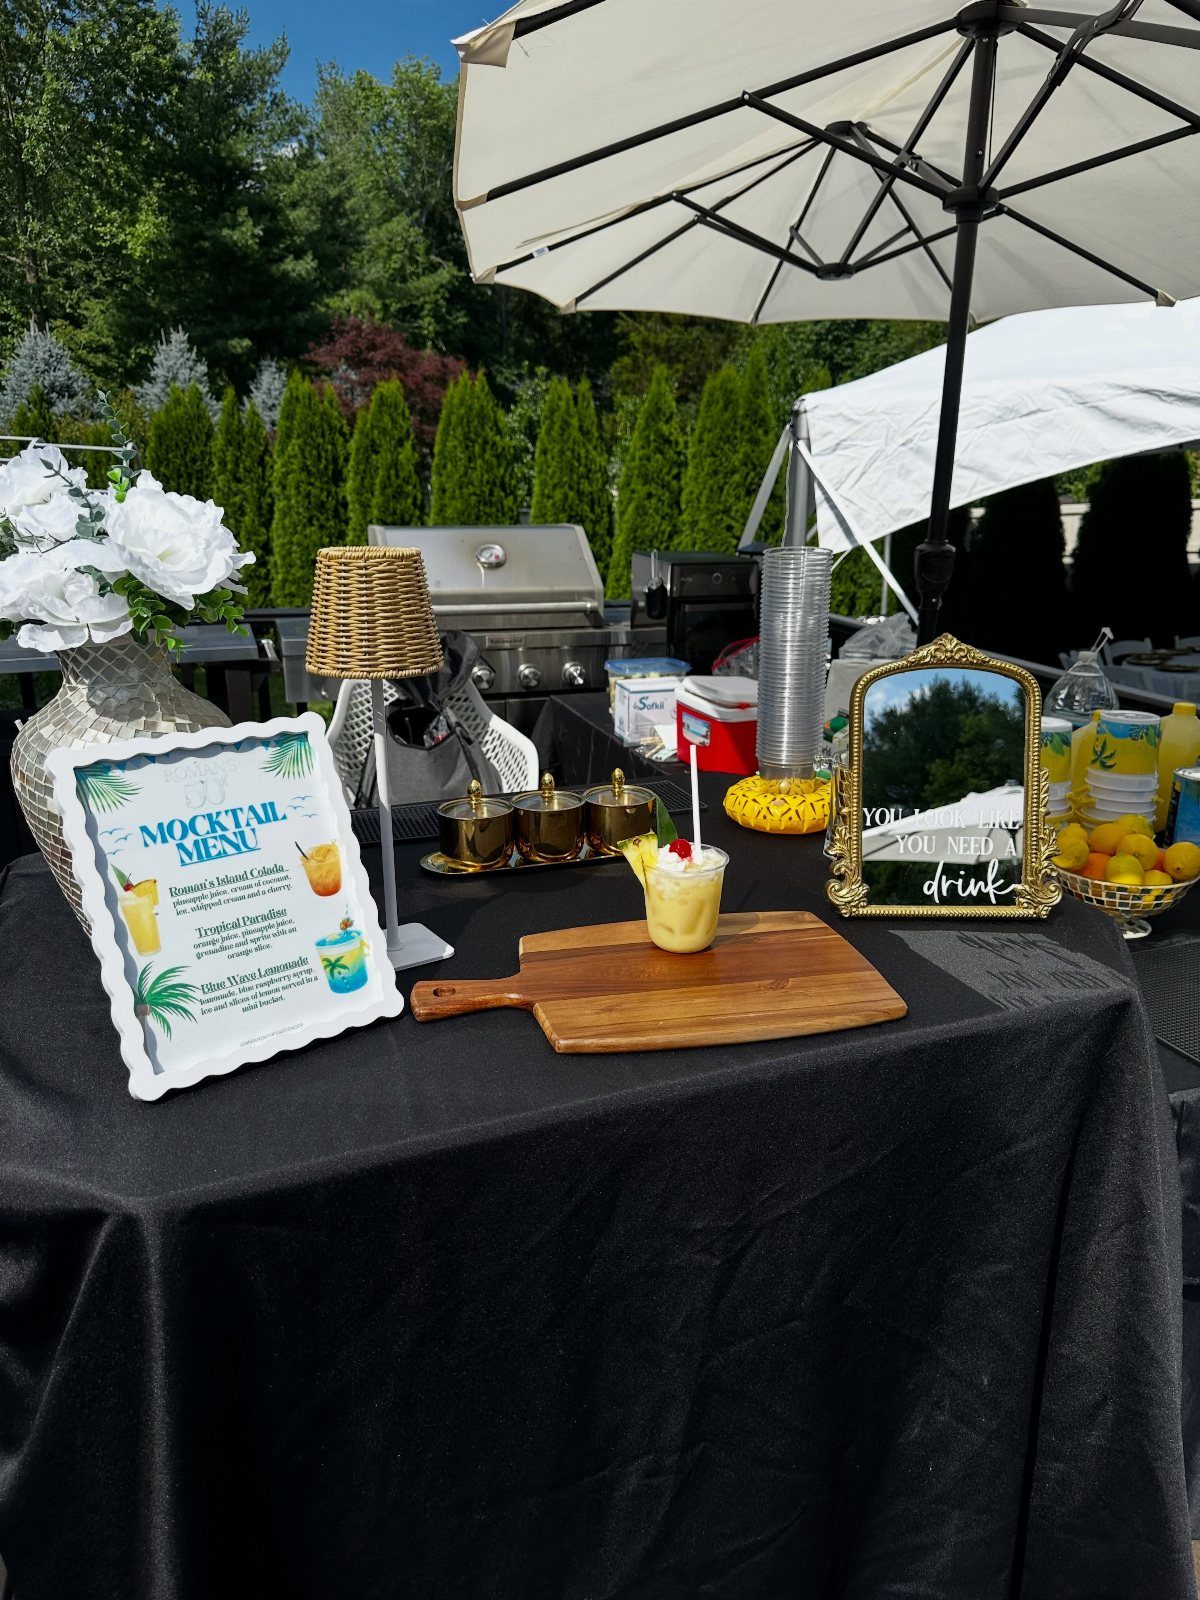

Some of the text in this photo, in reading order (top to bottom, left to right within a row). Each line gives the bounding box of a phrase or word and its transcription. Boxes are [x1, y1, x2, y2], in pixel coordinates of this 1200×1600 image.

[164, 759, 238, 783] ROMAN'S
[139, 801, 288, 848] MOCKTAIL
[862, 807, 1020, 830] YOU LOOK LIKE
[175, 827, 261, 866] MENU
[896, 835, 1017, 856] YOU NEED A
[168, 863, 285, 898] Roman's Island Colada
[173, 893, 209, 909] pineapple
[231, 883, 253, 893] cream
[254, 880, 261, 889] of
[922, 858, 1019, 905] drink
[190, 899, 222, 913] whipped
[223, 895, 246, 905] cream
[247, 890, 261, 899] and
[193, 937, 220, 949] orange
[241, 922, 276, 938] pineapple
[195, 908, 287, 938] Tropical Paradise
[195, 926, 297, 960] grenadine and sprite with an
[227, 948, 253, 960] orange
[200, 956, 309, 995] Blue Wave Lemonade
[238, 985, 254, 995] blue
[255, 973, 291, 991] raspberry
[201, 1005, 213, 1016] ice
[213, 1001, 228, 1012] and
[229, 996, 250, 1007] slices
[251, 992, 258, 1001] of
[259, 987, 281, 998] lemon
[281, 978, 305, 991] served
[305, 976, 313, 984] in
[241, 1004, 258, 1013] mini
